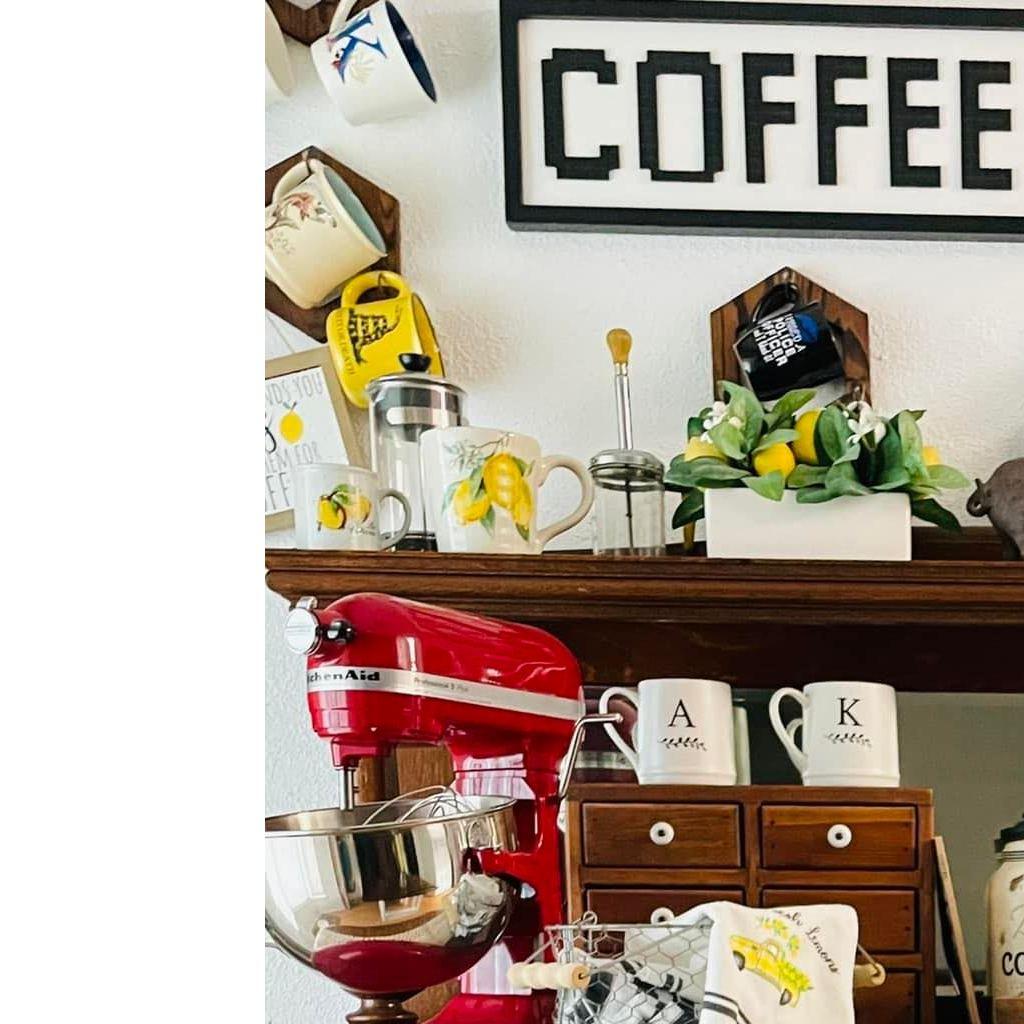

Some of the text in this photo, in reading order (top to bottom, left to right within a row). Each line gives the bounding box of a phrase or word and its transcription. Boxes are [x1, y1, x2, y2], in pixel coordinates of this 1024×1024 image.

[541, 47, 1013, 191] COFFEE
[761, 320, 789, 367] OFFICER
[772, 316, 797, 358] POLICE
[292, 371, 324, 398] YOU
[668, 699, 697, 728] A
[836, 698, 863, 727] K
